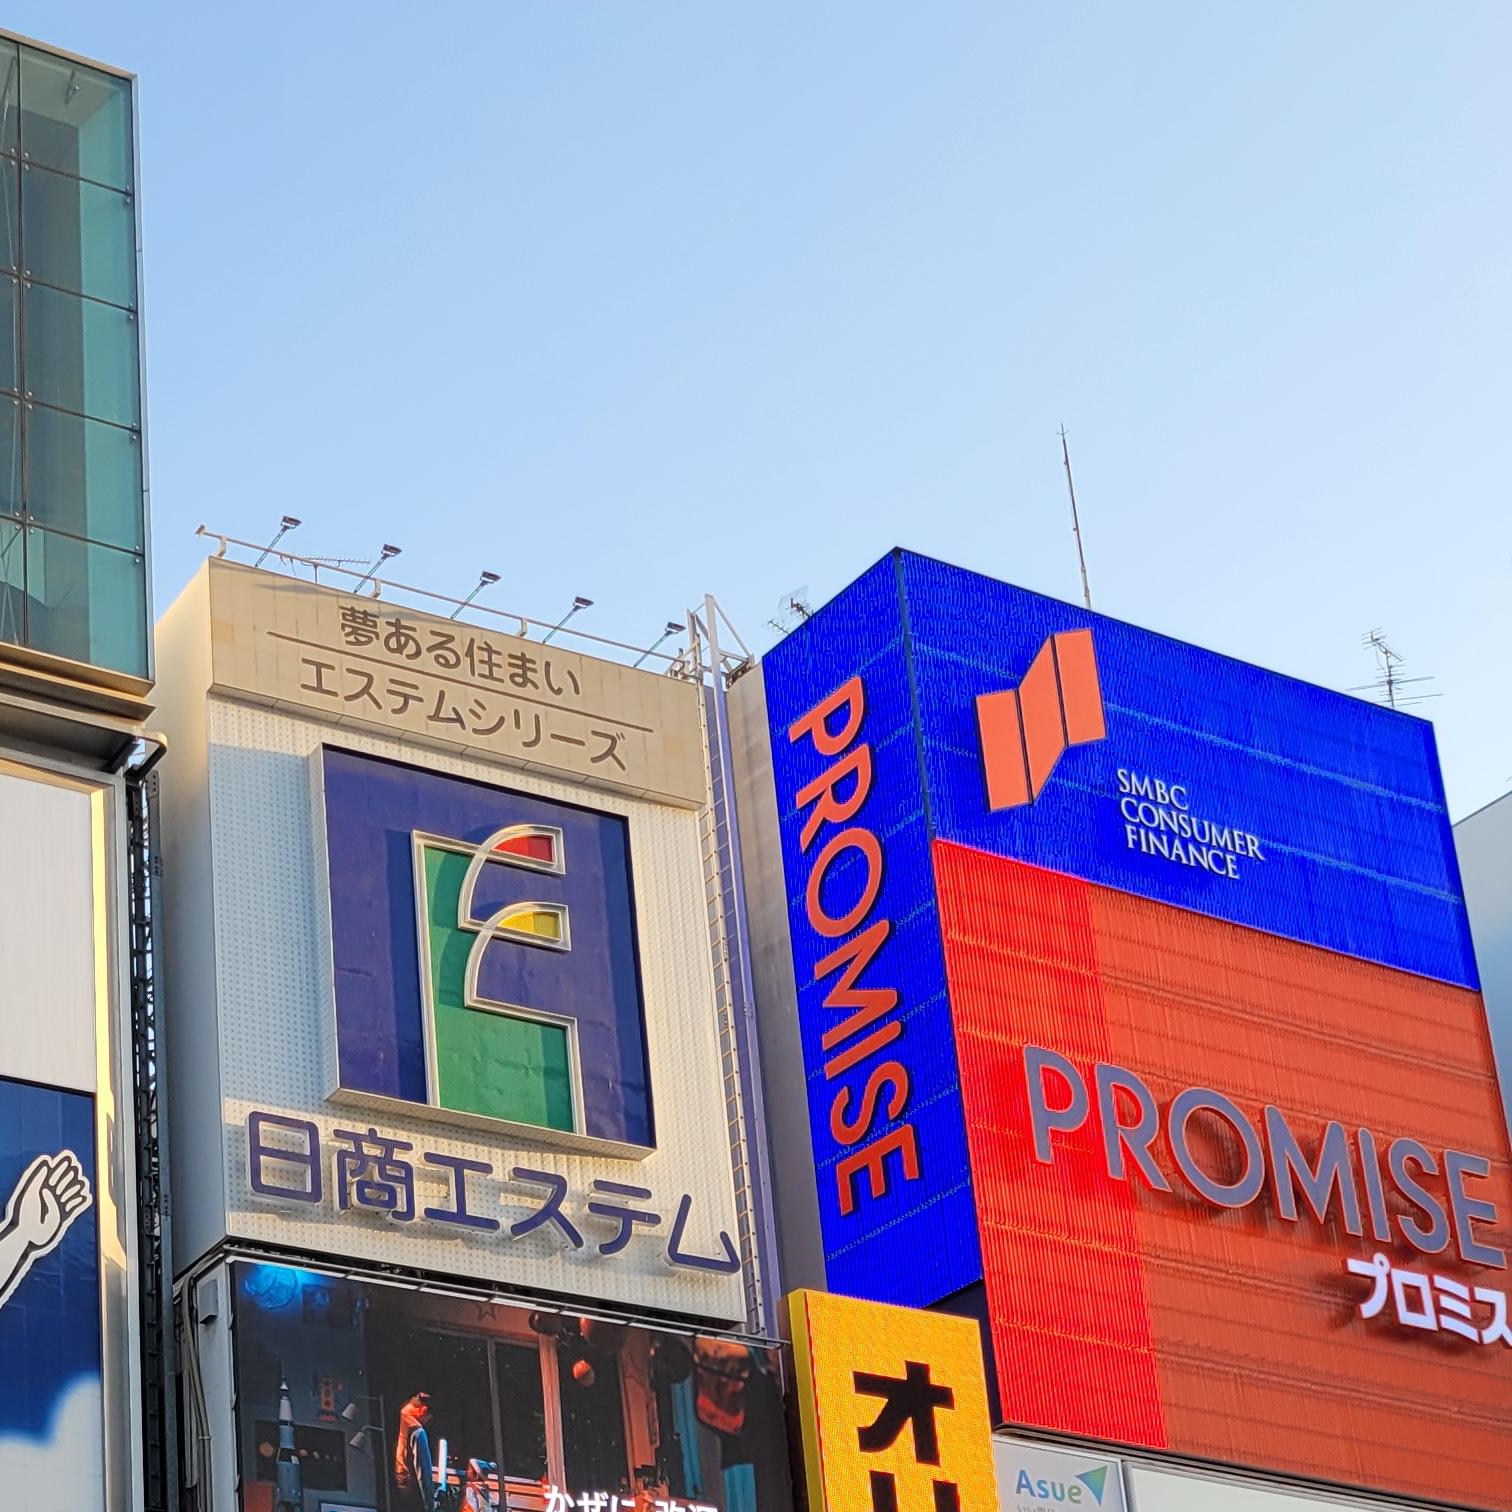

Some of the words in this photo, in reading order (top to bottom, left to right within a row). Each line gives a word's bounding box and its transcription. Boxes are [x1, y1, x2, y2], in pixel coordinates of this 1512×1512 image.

[338, 605, 581, 698] 夢ある住まい
[299, 657, 628, 773] エステムシリーズ
[1117, 768, 1189, 811] SMBC
[1120, 797, 1266, 861] CONSUMER
[1125, 824, 1241, 880] FINANCE
[787, 675, 920, 1218] PROMISE
[245, 1111, 742, 1277] 日商エステム
[1023, 1044, 1508, 1270] PROMISE
[1346, 1252, 1512, 1346] プロミス
[1016, 1469, 1082, 1505] Asue
